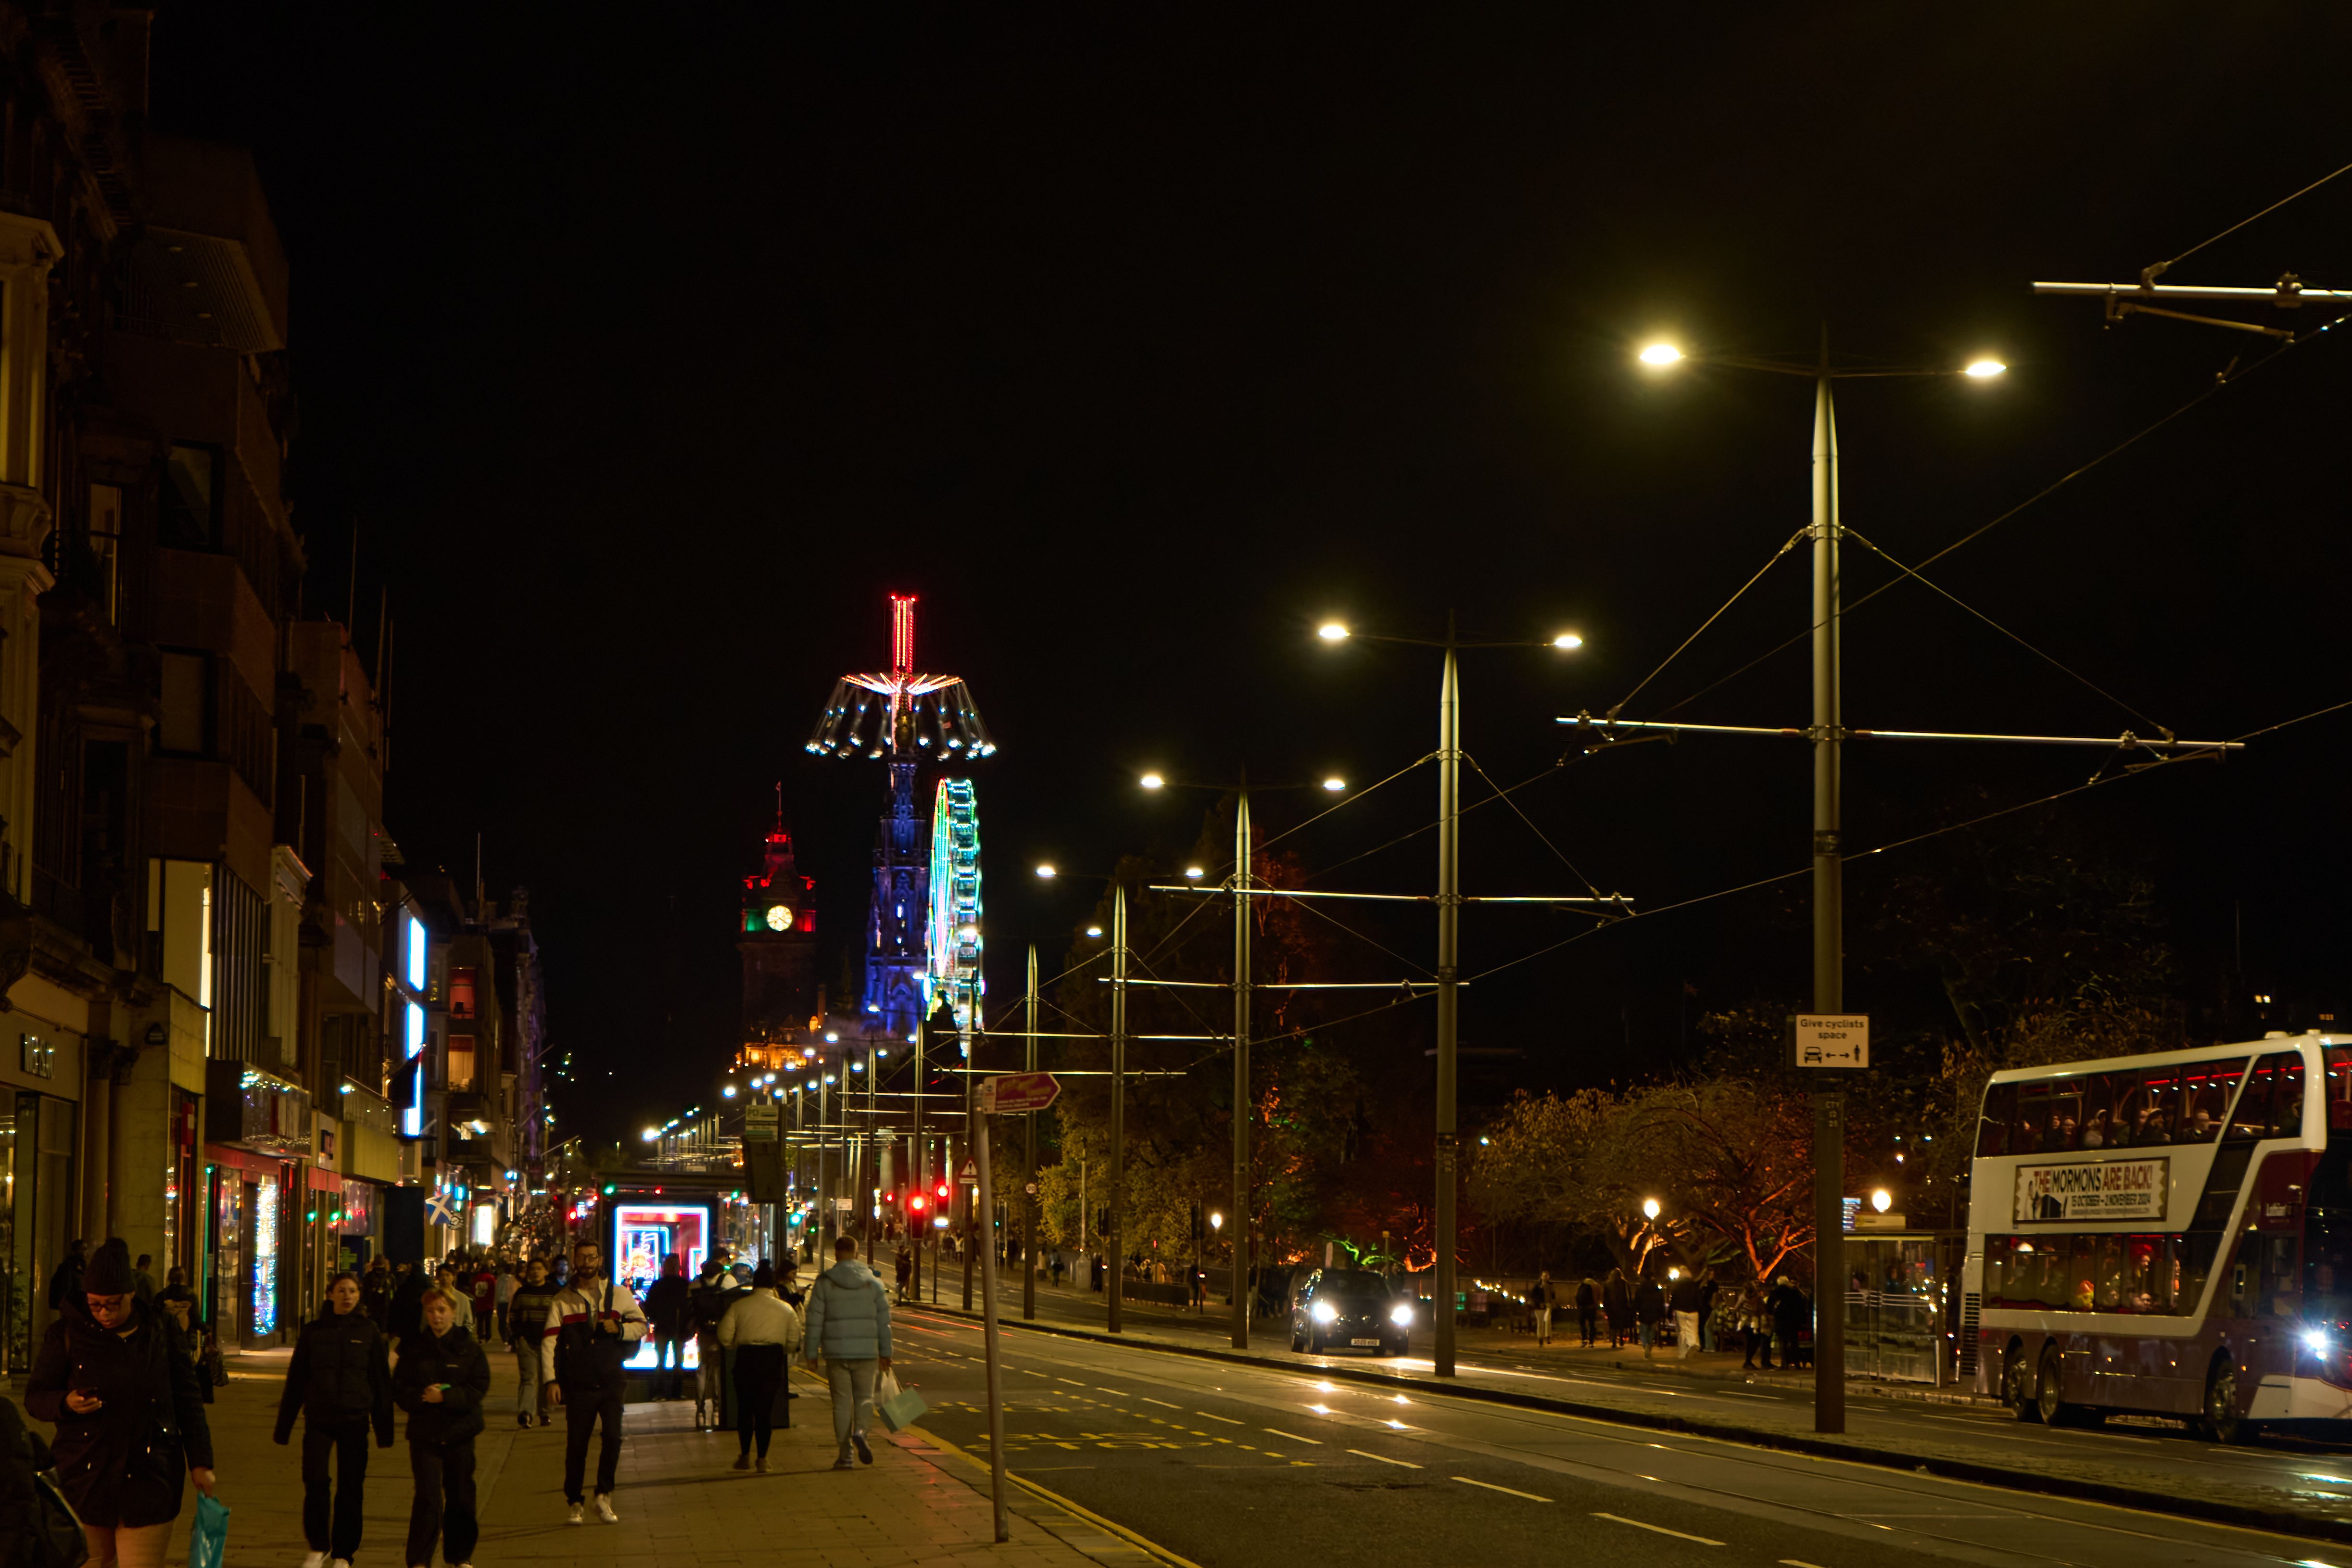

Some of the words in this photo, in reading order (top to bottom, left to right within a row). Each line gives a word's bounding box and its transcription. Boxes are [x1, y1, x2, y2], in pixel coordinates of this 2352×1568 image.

[1800, 1019, 1822, 1027] Give
[1825, 1018, 1864, 1029] cyclists
[2034, 1170, 2051, 1193] THE
[2052, 1168, 2101, 1193] MORMONS
[2102, 1166, 2122, 1190] ARE
[2124, 1165, 2152, 1190] BACK!
[2078, 1195, 2100, 1207] OCTOBER
[2109, 1193, 2137, 1206] NOVEMBER
